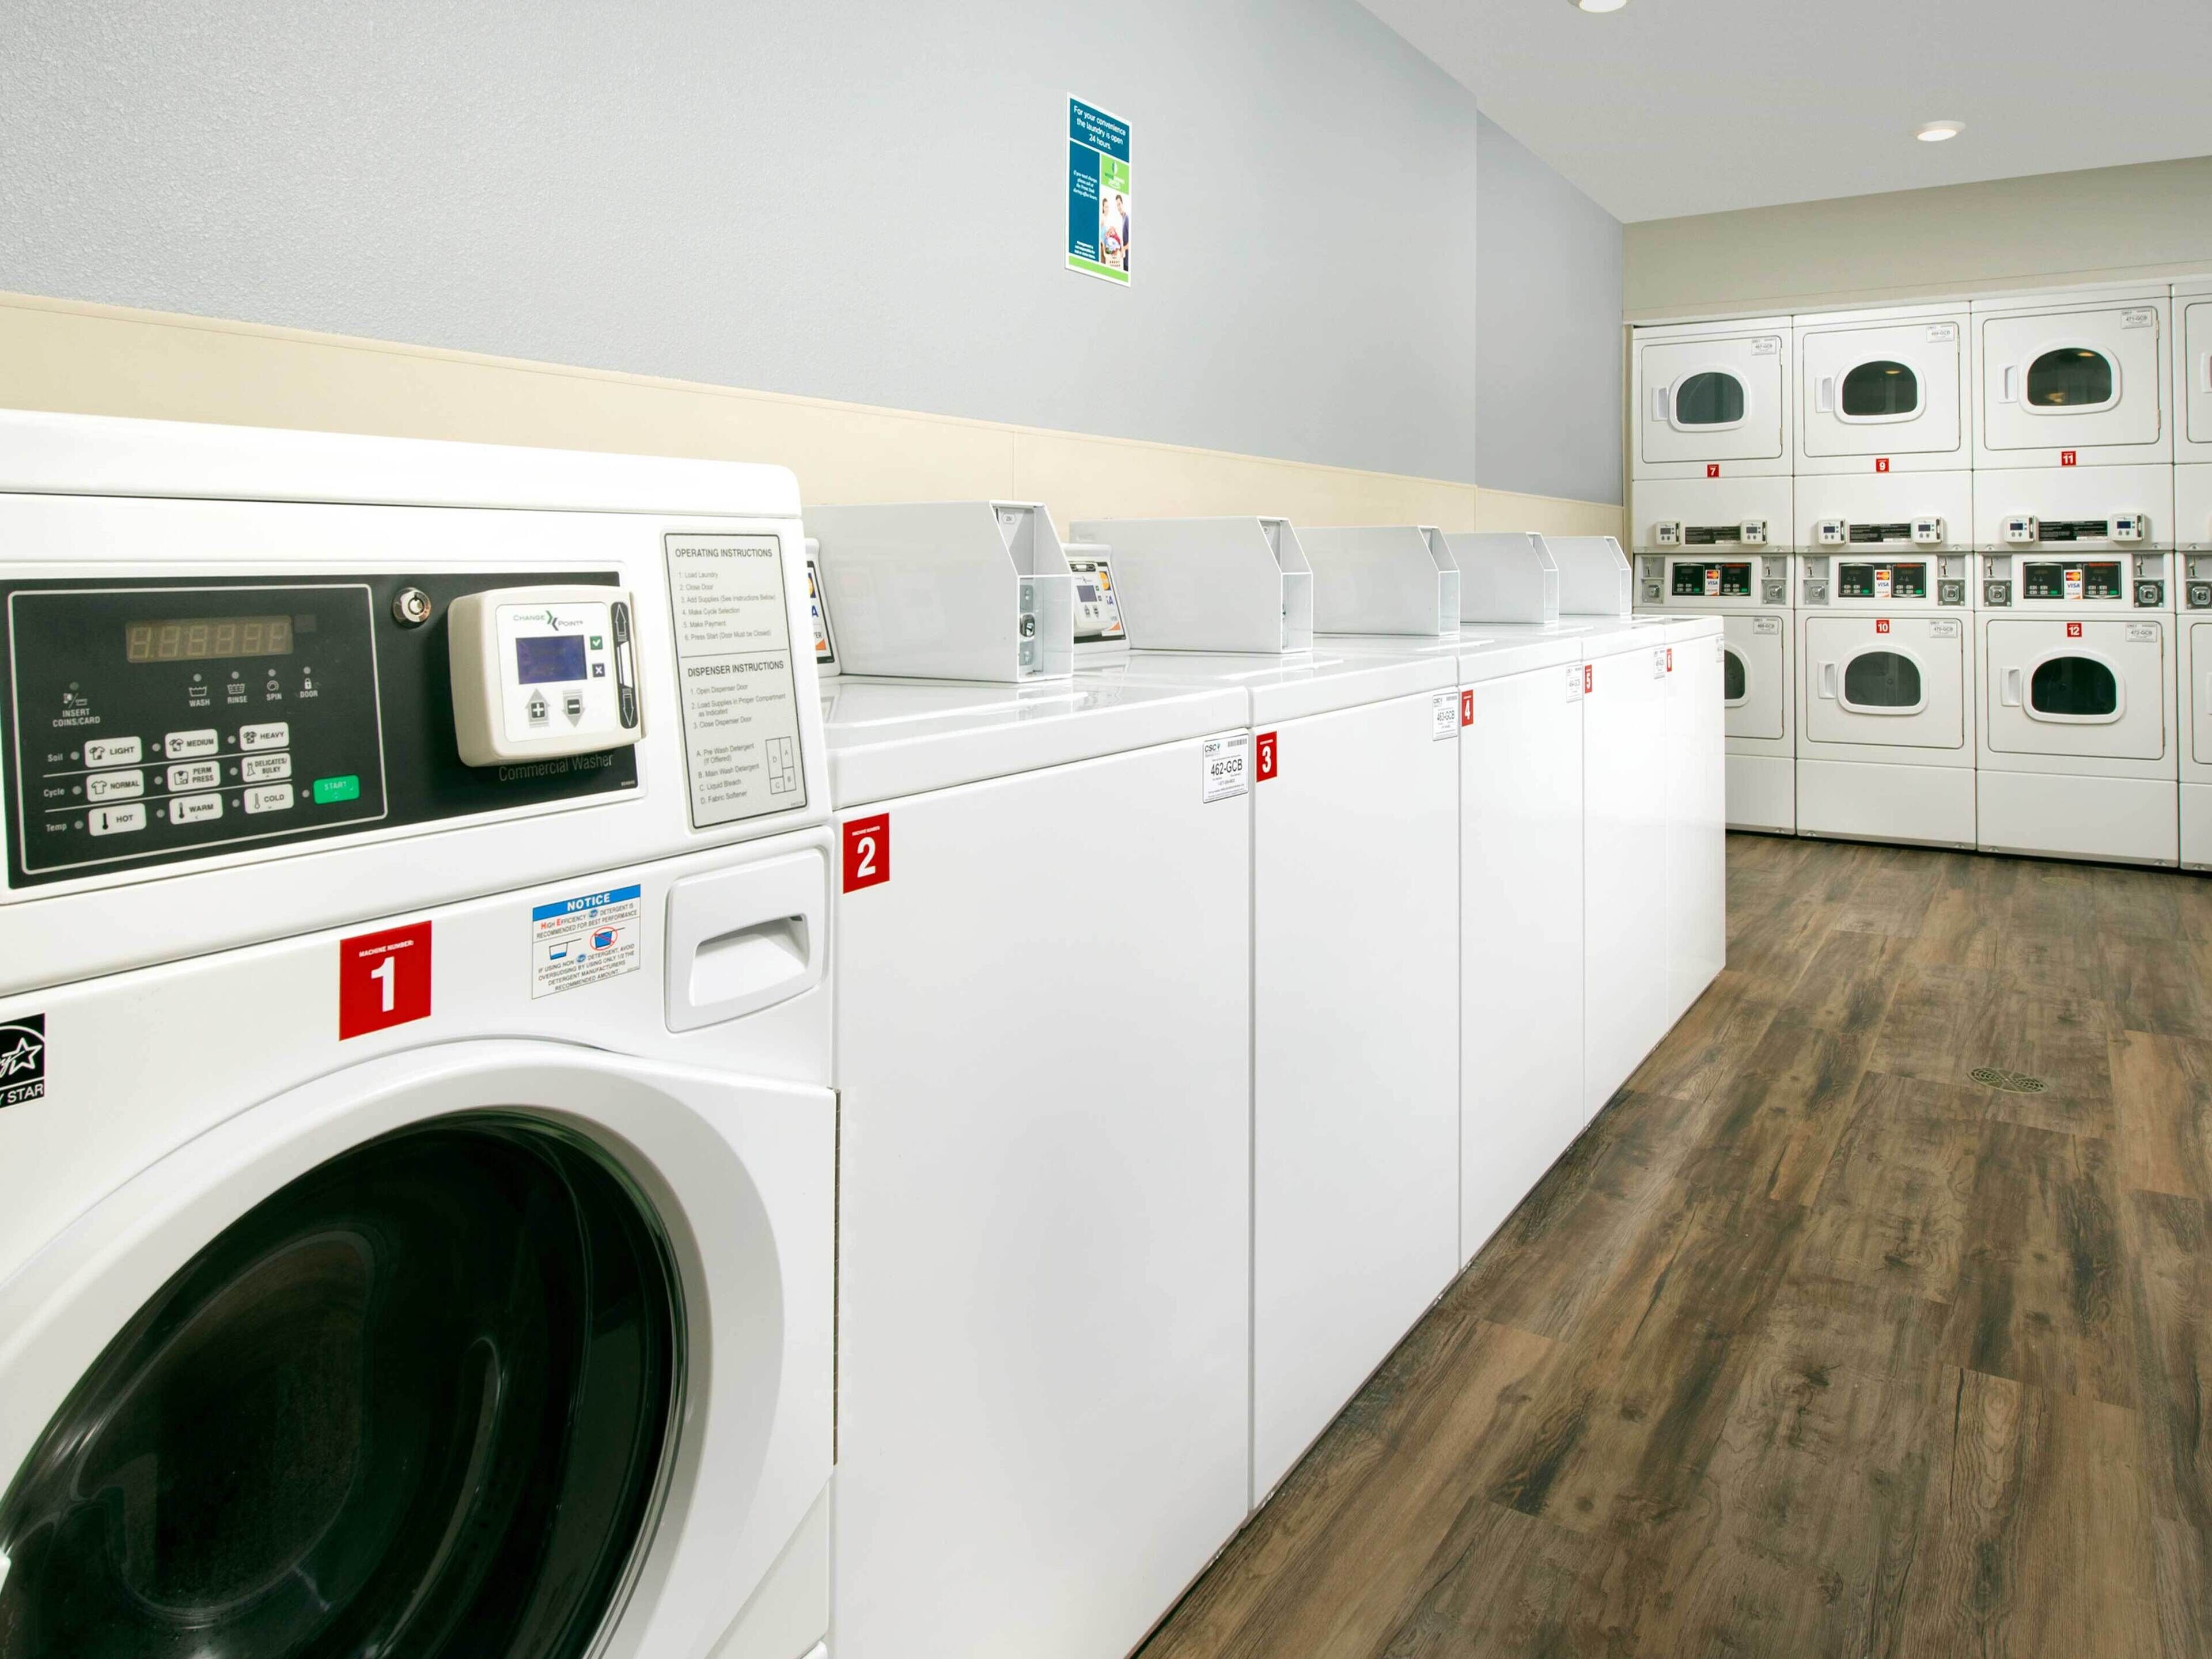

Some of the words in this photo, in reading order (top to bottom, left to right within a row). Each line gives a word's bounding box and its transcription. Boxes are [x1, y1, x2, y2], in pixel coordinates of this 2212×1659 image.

[1074, 105, 1083, 115] For
[1084, 112, 1096, 122] your
[1096, 118, 1126, 136] convenience
[1077, 118, 1086, 128] the
[1086, 122, 1105, 138] laundry
[1111, 135, 1123, 145] open
[1089, 134, 1096, 142] 24
[1097, 137, 1112, 150] hours.
[2063, 455, 2074, 464] 11
[1879, 461, 1886, 471] 9
[1710, 467, 1716, 476] 7
[675, 548, 719, 557] OPERATING
[721, 548, 772, 557] INSTRUCTIONS
[698, 596, 719, 604] Supplies
[1878, 623, 1888, 632] 10
[2069, 627, 2080, 635] 12
[688, 665, 730, 677] DISPENSER
[733, 661, 784, 673] INSTRUCTIONS
[1586, 672, 1591, 690] 5
[300, 690, 318, 698] DOOR
[711, 685, 736, 694] Dispenser
[228, 696, 248, 704] RINSE
[266, 693, 282, 701] SPIN
[711, 700, 732, 708] Supplies
[756, 694, 786, 702] Compartment
[189, 699, 210, 707] WASH
[62, 708, 90, 717] INSERT
[1465, 699, 1471, 720] 4
[52, 716, 101, 728] COINS/CARD
[715, 718, 740, 727] Dispenser
[260, 732, 284, 740] HEAVY
[187, 738, 214, 747] MEDIUM
[110, 747, 134, 755] LIGHT
[730, 743, 755, 752] Detergent
[1205, 744, 1217, 752] CSC
[47, 753, 63, 762] Soil
[710, 755, 732, 764] Offered)
[1262, 745, 1271, 773] 3
[255, 758, 287, 767] DELICATES/
[193, 767, 212, 775] PERM
[262, 766, 281, 774] BULKY
[499, 758, 569, 782] Commercial
[571, 753, 613, 770] Washer
[735, 763, 760, 773] Detergent
[1211, 759, 1243, 776] 462-GCB
[192, 775, 214, 783] PRESS
[110, 781, 139, 790] NORMAL
[324, 781, 346, 791] START
[707, 782, 723, 790] Liquid
[724, 779, 741, 787] Bleach
[43, 787, 65, 798] Cycle
[726, 791, 747, 800] Softener
[264, 794, 285, 802] COLD
[189, 804, 214, 813] WARM
[116, 815, 134, 823] HOT
[46, 823, 67, 832] Temp
[857, 836, 876, 878] 2
[567, 893, 611, 911] NOTICE
[541, 921, 555, 930] HIGH
[556, 914, 586, 926] EFFICIENCY
[600, 904, 629, 916] DETERGENT
[536, 924, 576, 939] RECOMMENDED
[588, 918, 601, 927] BEST
[602, 910, 637, 923] PERFORMANCE
[359, 945, 387, 957] MACHINE
[544, 963, 562, 972] USING
[620, 944, 634, 952] AVOID
[539, 967, 577, 981] OVERSUDSING
[586, 959, 602, 968] USING
[603, 956, 616, 964] ONLY
[548, 974, 581, 986] DETERGENT
[581, 960, 626, 978] MANUFACTURERS
[371, 956, 395, 1013] 1
[555, 976, 596, 991] RECOMMENDED
[7, 1083, 43, 1103] STAR
